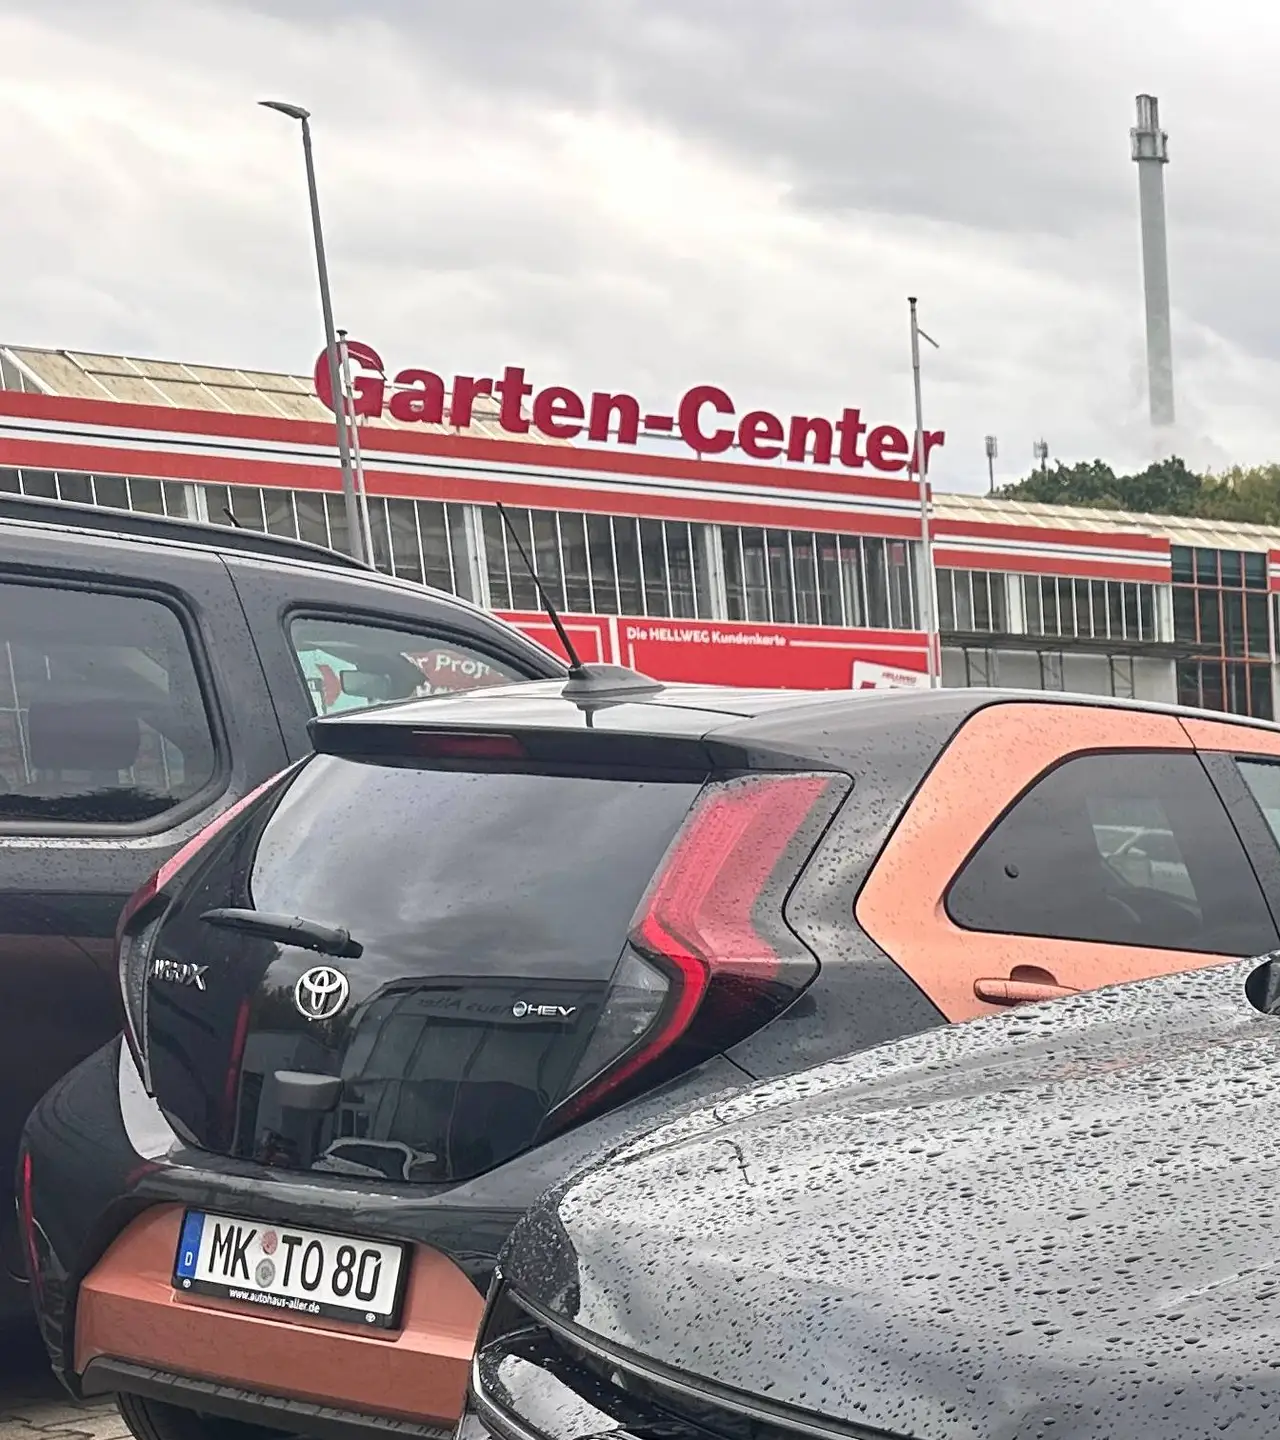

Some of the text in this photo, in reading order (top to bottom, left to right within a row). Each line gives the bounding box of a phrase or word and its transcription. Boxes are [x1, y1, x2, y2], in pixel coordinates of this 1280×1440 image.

[314, 340, 945, 474] Garten-Center
[626, 627, 787, 647] Die HELLWEG Kundenkarte
[527, 1005, 576, 1017] HEV
[183, 1252, 194, 1267] D
[208, 1223, 382, 1302] MK TO 80
[229, 1287, 321, 1314] www.autohaus-aller.de
